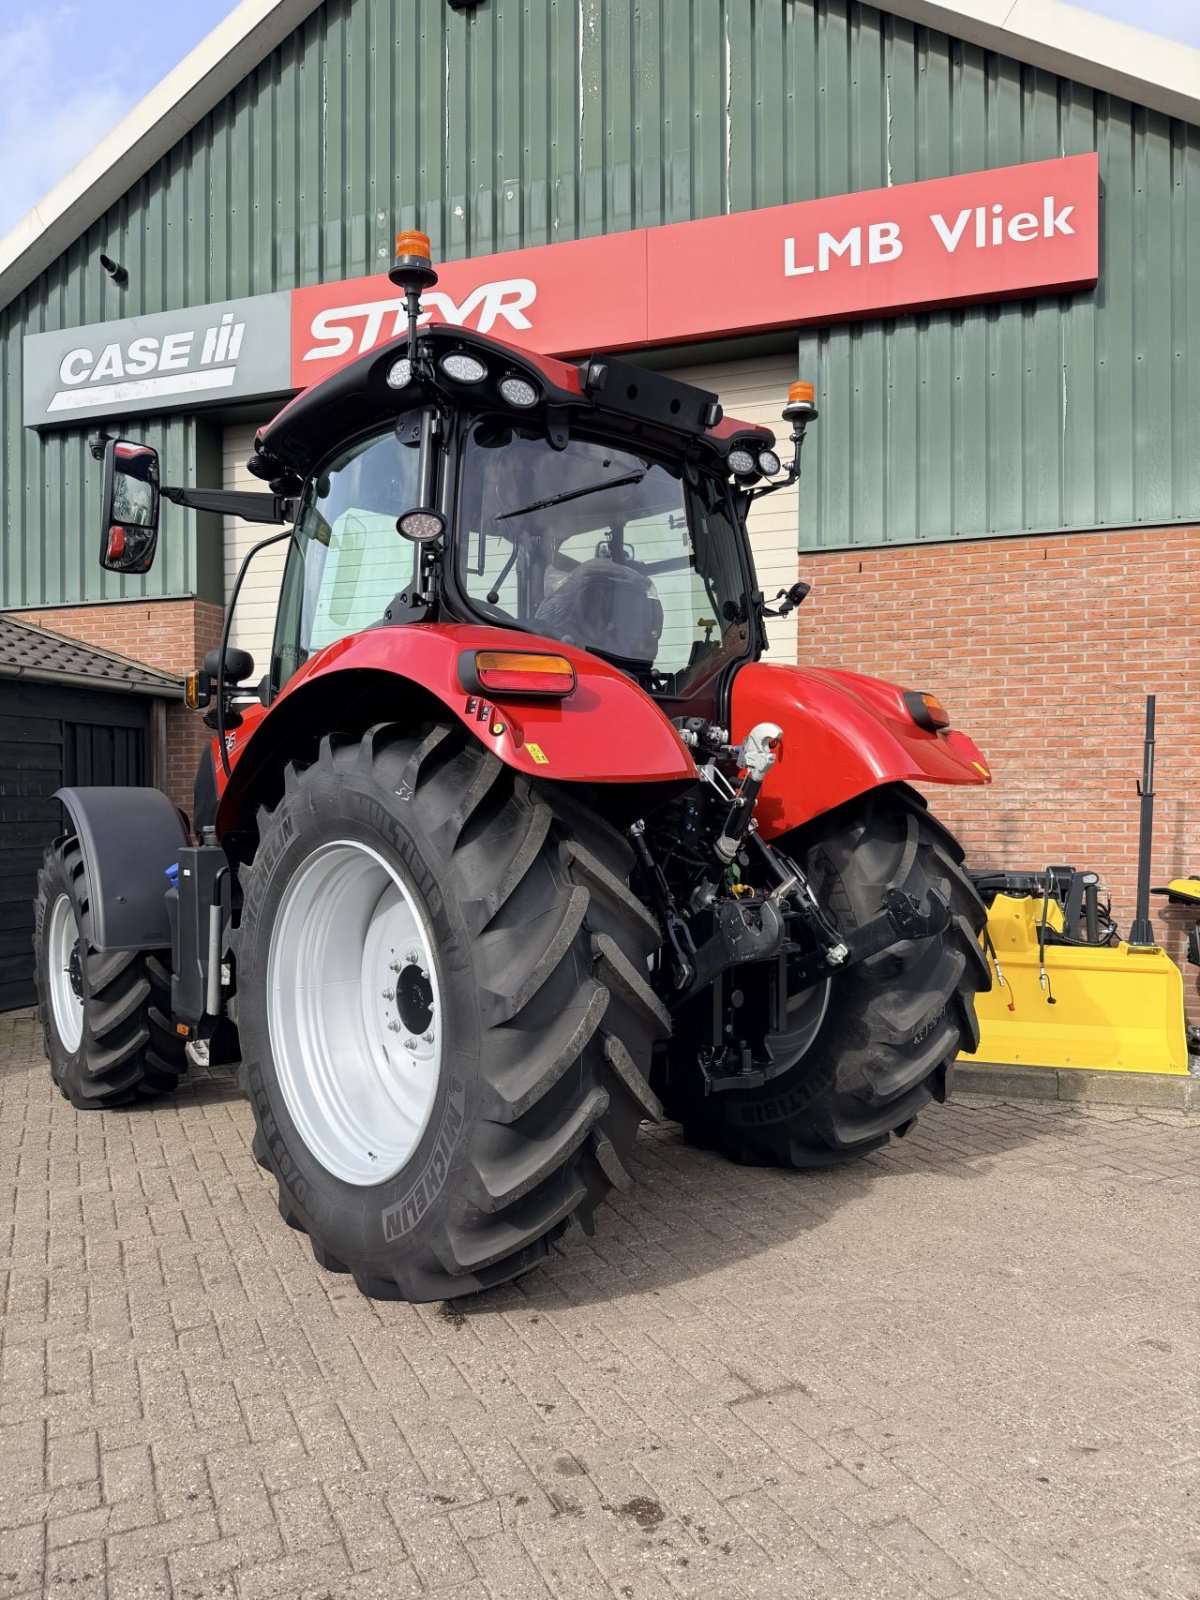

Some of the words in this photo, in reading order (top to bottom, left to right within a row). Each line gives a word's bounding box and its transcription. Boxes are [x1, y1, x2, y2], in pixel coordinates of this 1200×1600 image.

[784, 222, 903, 277] LMB
[929, 196, 1075, 253] Vliek
[59, 330, 195, 385] CASE
[245, 813, 294, 927] MICHELIN
[384, 1101, 463, 1241] MICHELIN
